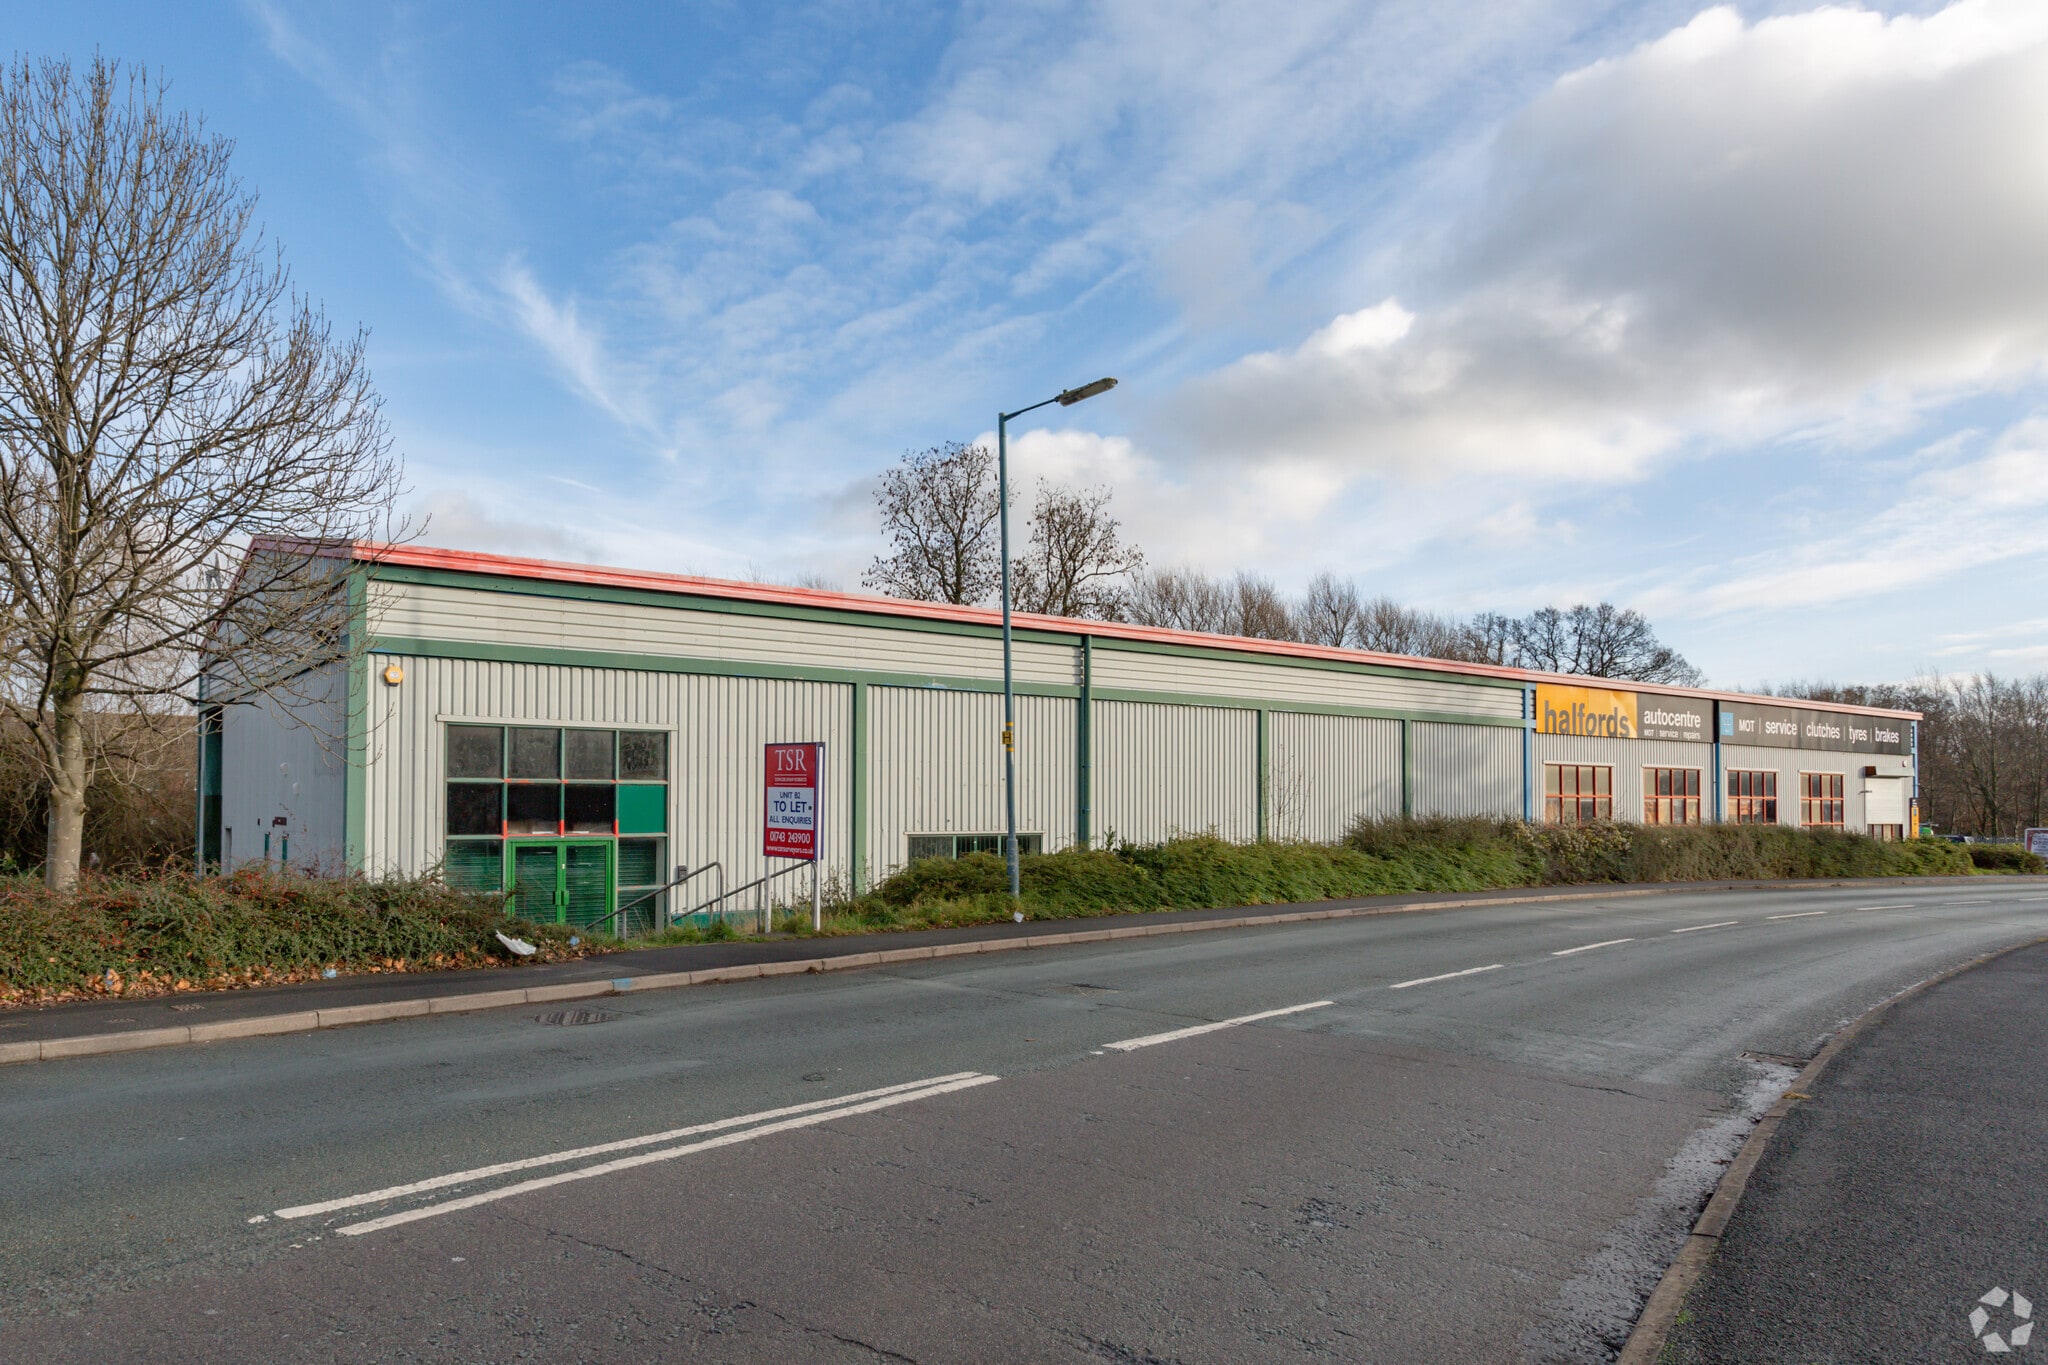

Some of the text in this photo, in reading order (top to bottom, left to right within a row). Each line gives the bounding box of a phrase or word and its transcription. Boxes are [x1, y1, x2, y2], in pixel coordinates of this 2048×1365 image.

[1545, 700, 1630, 738] halfords
[1643, 708, 1701, 728] autocentre
[1644, 729, 1701, 740] MOT service repairs
[1738, 718, 1899, 744] MOT service clutches tyres brakes
[775, 748, 807, 771] TSR
[780, 791, 793, 799] UNIT
[774, 801, 807, 813] TO LET
[769, 815, 812, 825] ALL ENQUIRIES
